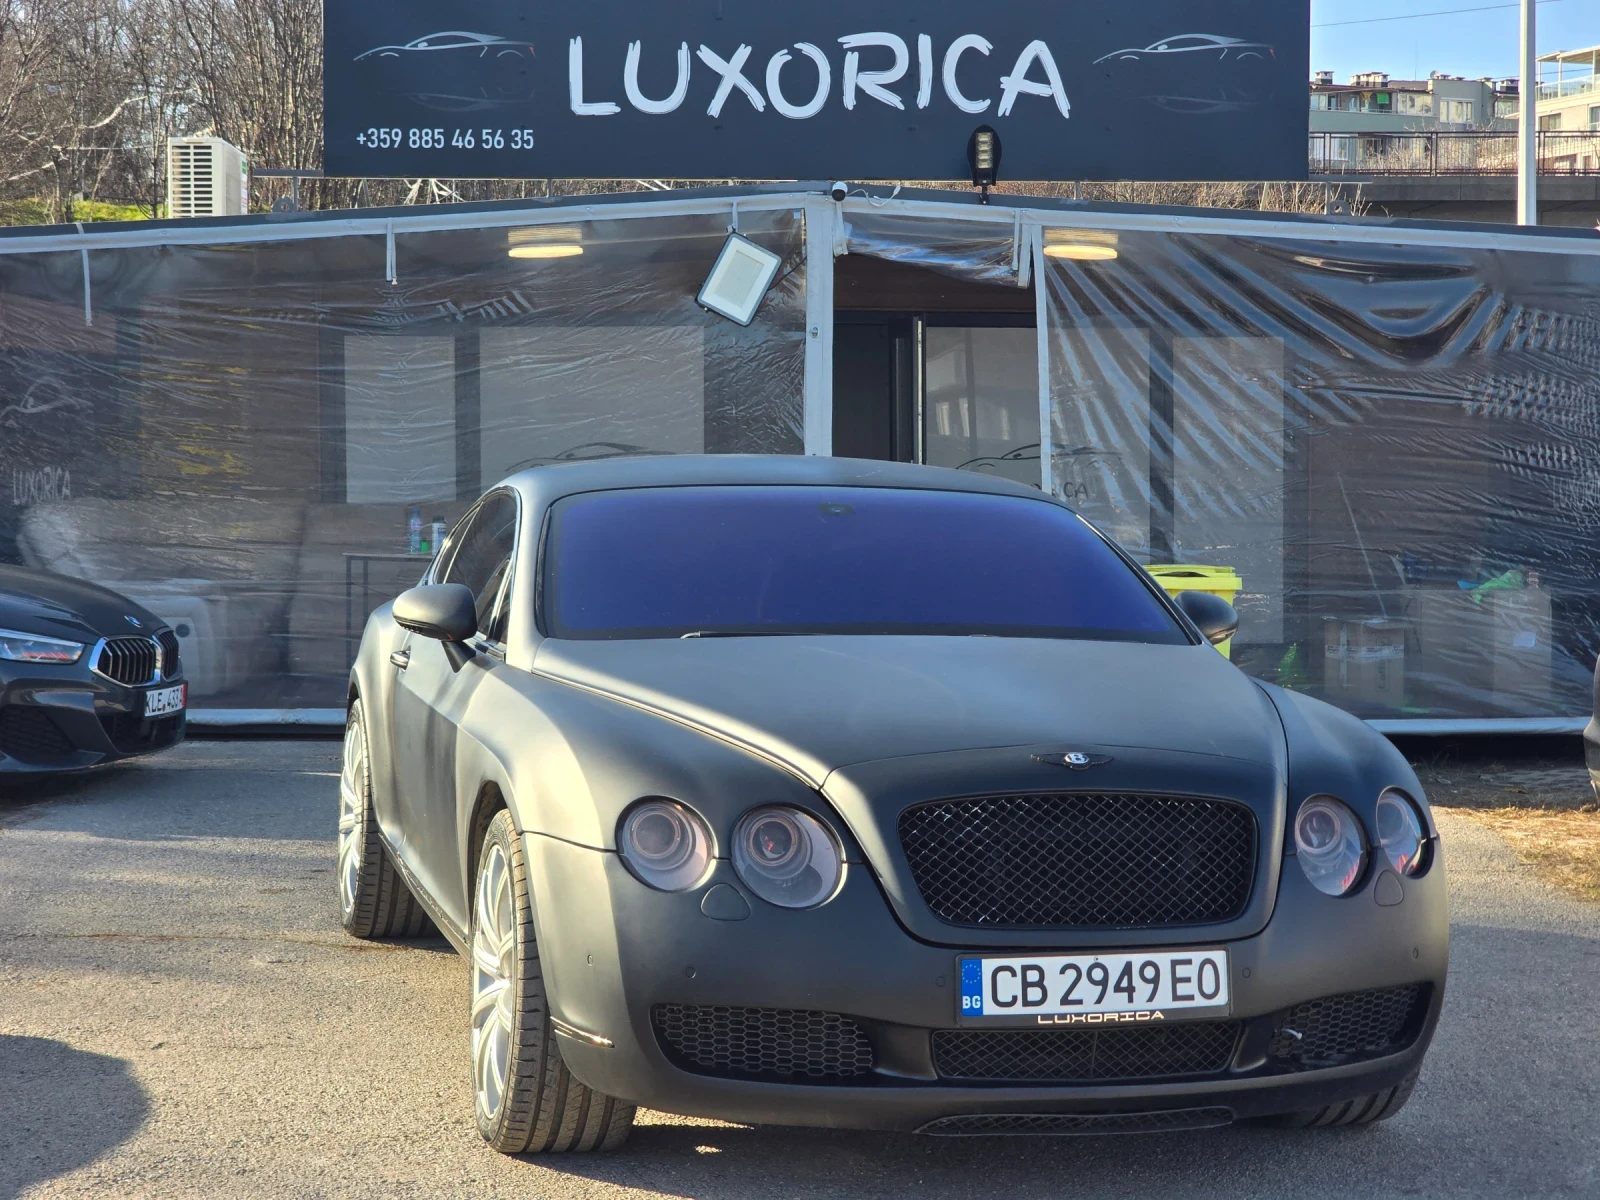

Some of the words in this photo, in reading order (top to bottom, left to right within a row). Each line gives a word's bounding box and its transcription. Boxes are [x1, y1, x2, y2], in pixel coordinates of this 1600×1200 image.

[569, 32, 1071, 119] LUXORICA
[356, 128, 402, 149] +359
[408, 128, 445, 149] 885
[451, 128, 475, 149] 46
[481, 129, 505, 149] 56
[510, 129, 534, 149] 35
[990, 963, 1049, 1009] CB
[1059, 960, 1161, 1007] 2949
[962, 994, 981, 1010] BG
[1037, 1010, 1165, 1025] LUXORICA
